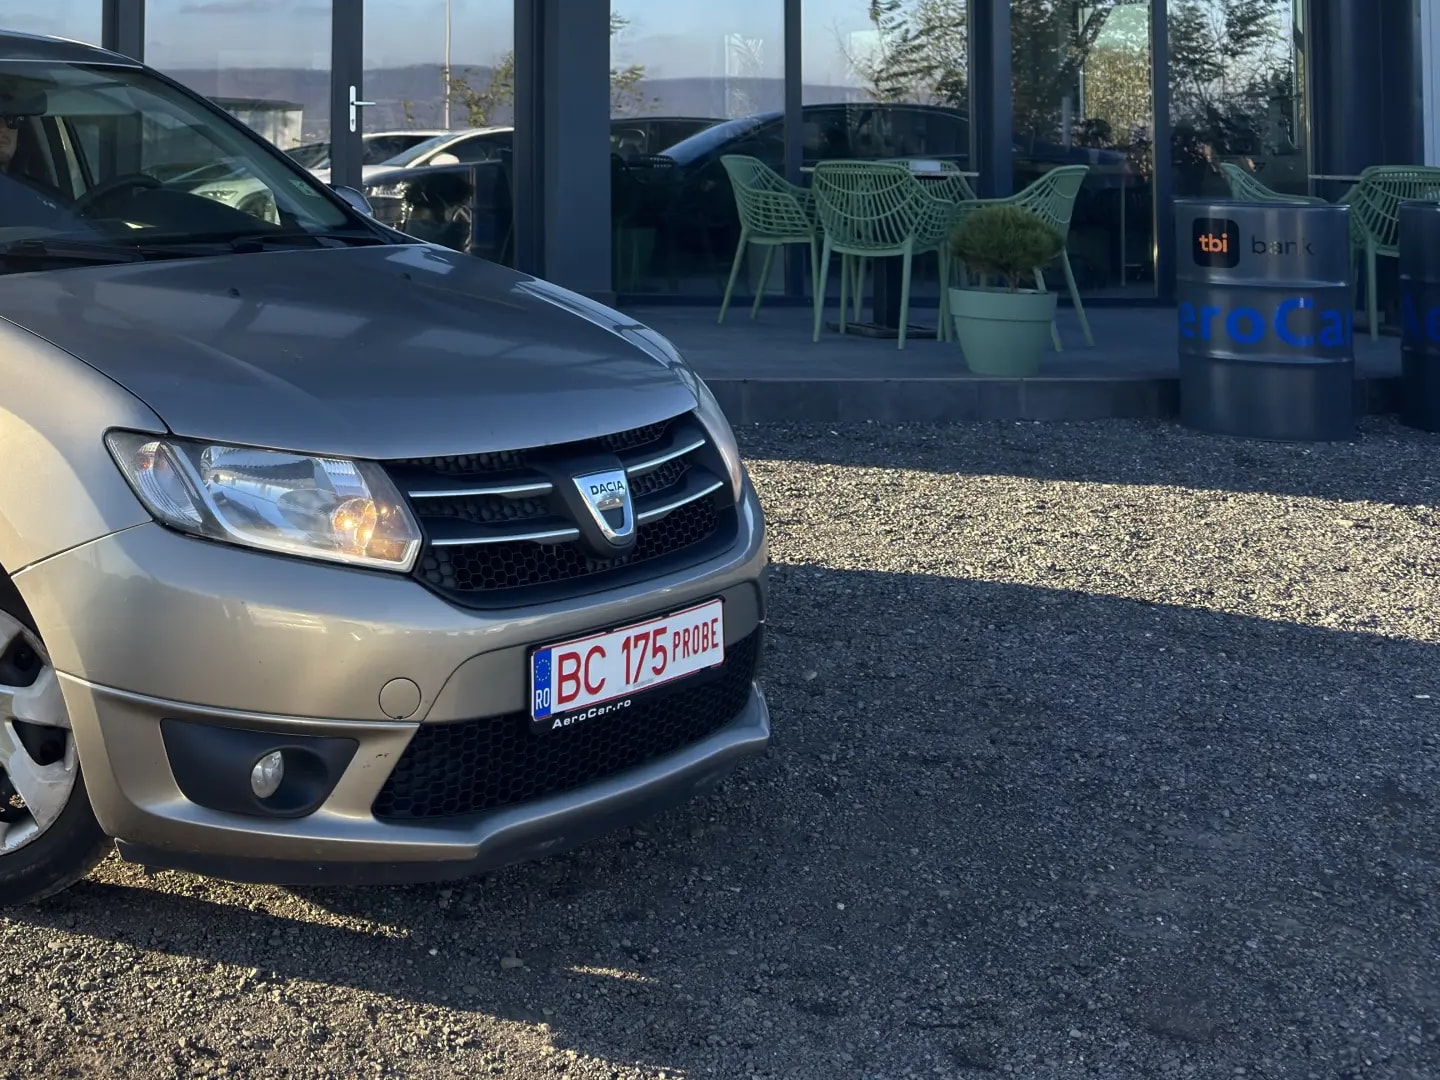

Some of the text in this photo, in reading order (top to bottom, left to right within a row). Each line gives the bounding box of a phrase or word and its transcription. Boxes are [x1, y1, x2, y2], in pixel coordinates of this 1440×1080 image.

[1199, 233, 1315, 256] tbi bank
[590, 480, 625, 495] DACIA
[535, 618, 719, 710] RO BC 175 PROBE
[552, 699, 632, 730] AeroCar.ro
